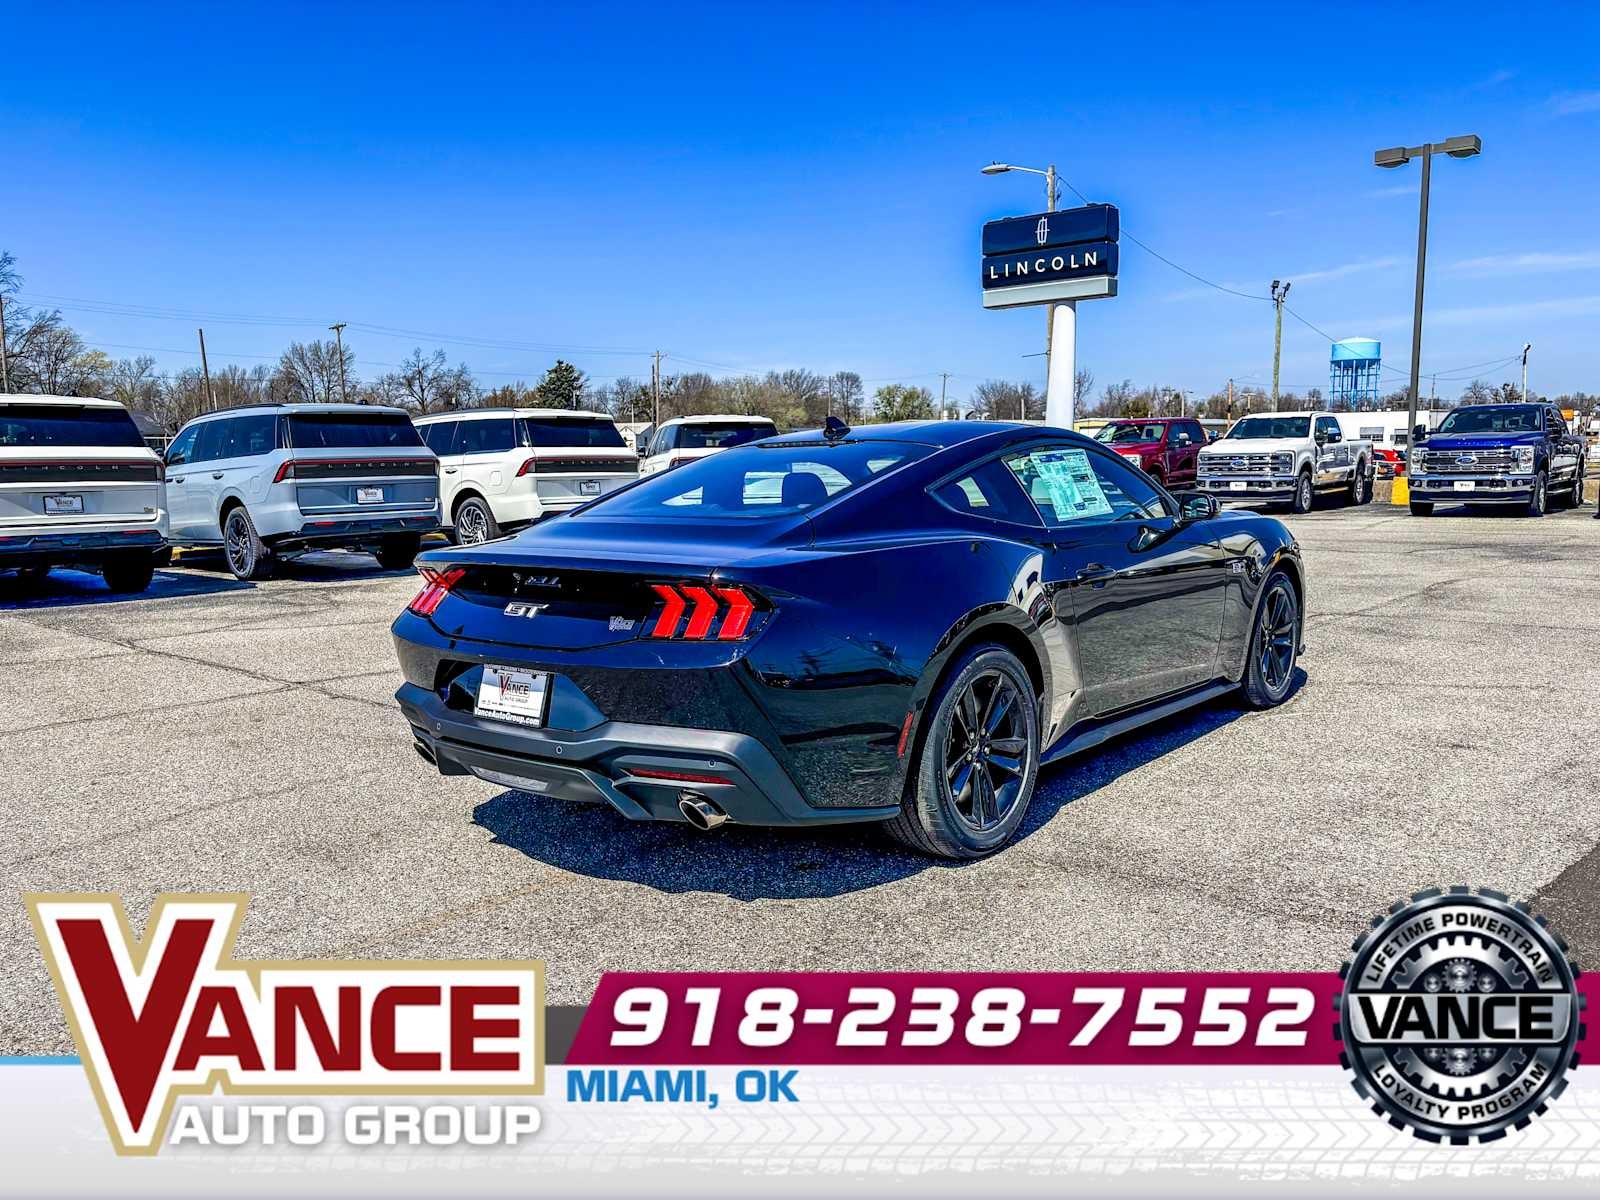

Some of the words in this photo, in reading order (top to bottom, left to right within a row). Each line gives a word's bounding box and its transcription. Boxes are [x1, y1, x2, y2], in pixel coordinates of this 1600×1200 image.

[990, 251, 1098, 280] LINCOLN
[503, 601, 551, 619] GT
[499, 673, 529, 696] VANCE
[474, 706, 541, 726] VanceAutoGroup.com
